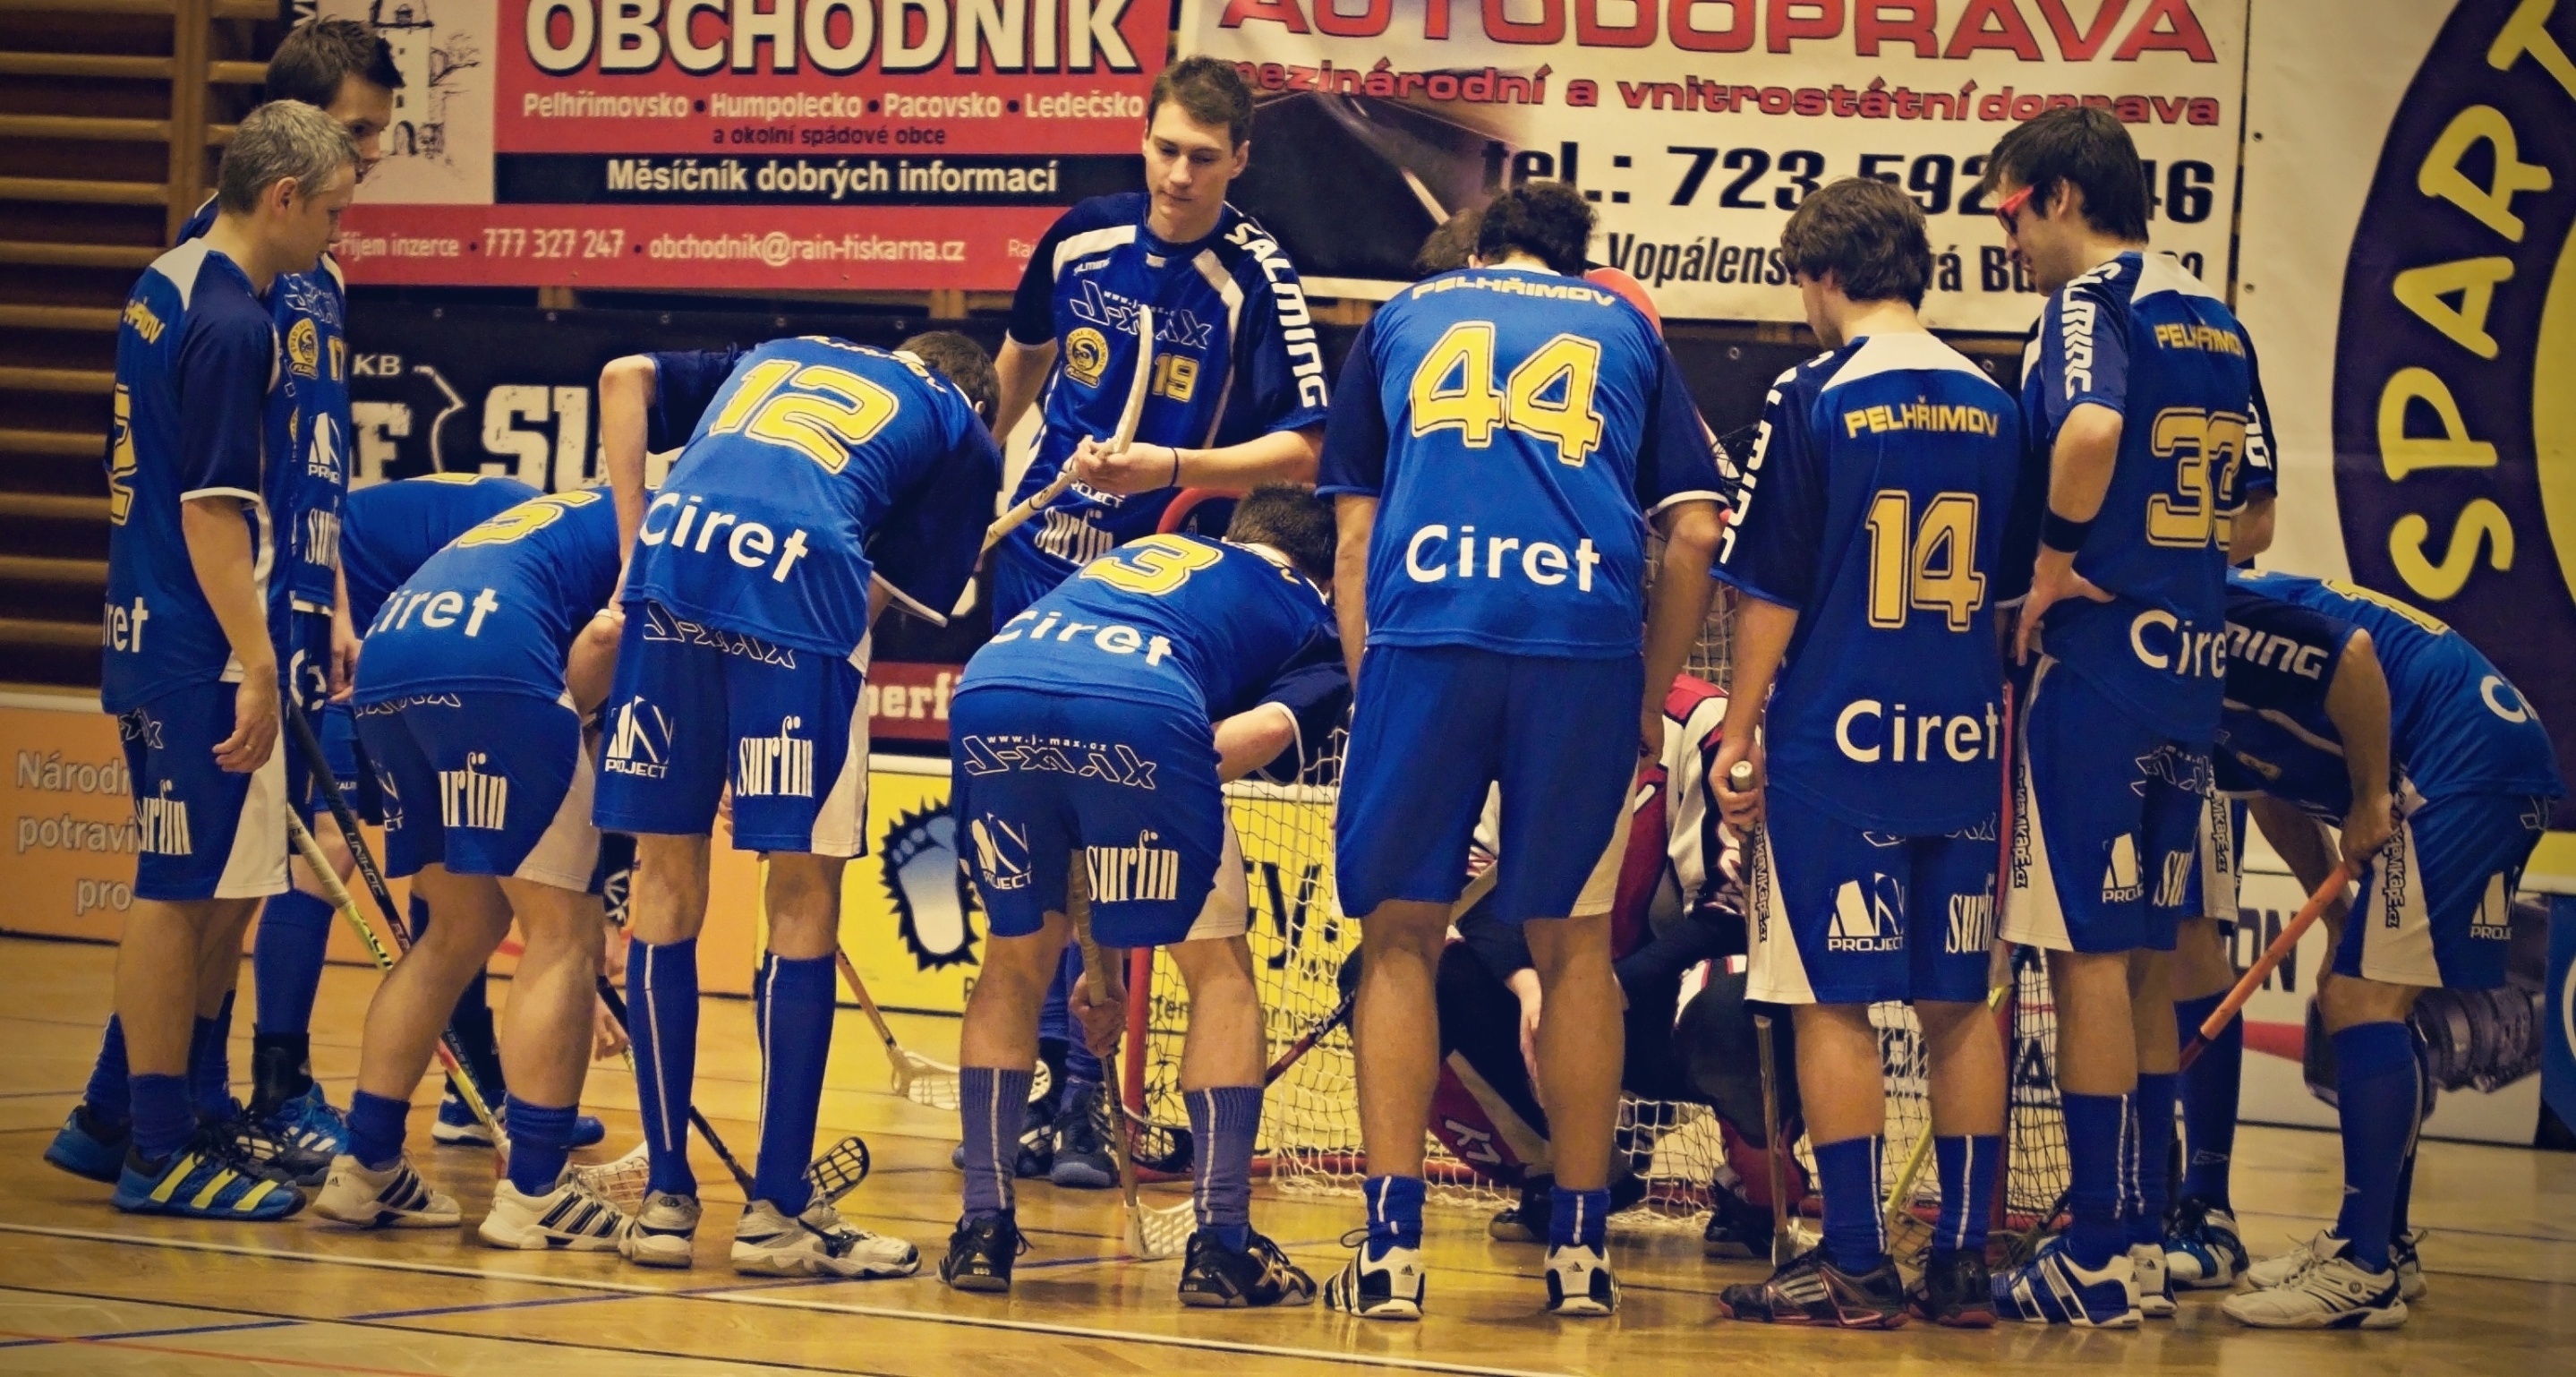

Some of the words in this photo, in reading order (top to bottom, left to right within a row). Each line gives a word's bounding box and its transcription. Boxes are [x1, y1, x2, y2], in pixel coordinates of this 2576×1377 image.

[522, 90, 689, 119] Pelhřimovsko
[711, 92, 862, 123] Humpolecko
[883, 93, 1002, 119] Pacovsko
[1025, 90, 1144, 119] Ledečsko
[1565, 78, 1599, 107] a
[1619, 75, 1975, 121] vnitrostátní
[713, 130, 724, 143] a
[730, 124, 796, 144] okolní
[801, 124, 890, 148] spádové
[895, 127, 946, 144] obce
[607, 159, 748, 192] Měsíčník
[757, 159, 889, 200] dobrých
[899, 159, 1058, 192] informací
[1481, 140, 1633, 205] tel.:
[1667, 146, 1826, 211] 723
[329, 231, 388, 261] říjem
[391, 232, 460, 257] inzerce
[483, 228, 526, 258] 777
[533, 229, 577, 258] 327
[582, 229, 625, 258] 247
[1608, 232, 1792, 288] Vopálens
[1224, 221, 1327, 408] SALMING
[1412, 277, 1616, 307] PELHŘIMOV
[1153, 353, 1199, 403] 19
[1411, 320, 1605, 467] 44
[708, 360, 900, 475] 12
[1844, 394, 1999, 439] PELHŘIMOV
[1070, 478, 1126, 509] ROJECT
[639, 492, 808, 583] Ciret
[1405, 524, 1600, 592] Ciret
[1864, 489, 1985, 632] 14
[1078, 533, 1224, 597] 3
[365, 587, 499, 637] iret
[988, 611, 1173, 668] Ciret
[2129, 609, 2227, 679] Cire
[986, 734, 1107, 752] www.j-max.cz
[1835, 697, 2001, 764] Ciret
[17, 750, 135, 796] Národ
[19, 813, 139, 853] potravi
[76, 877, 132, 916] pro
